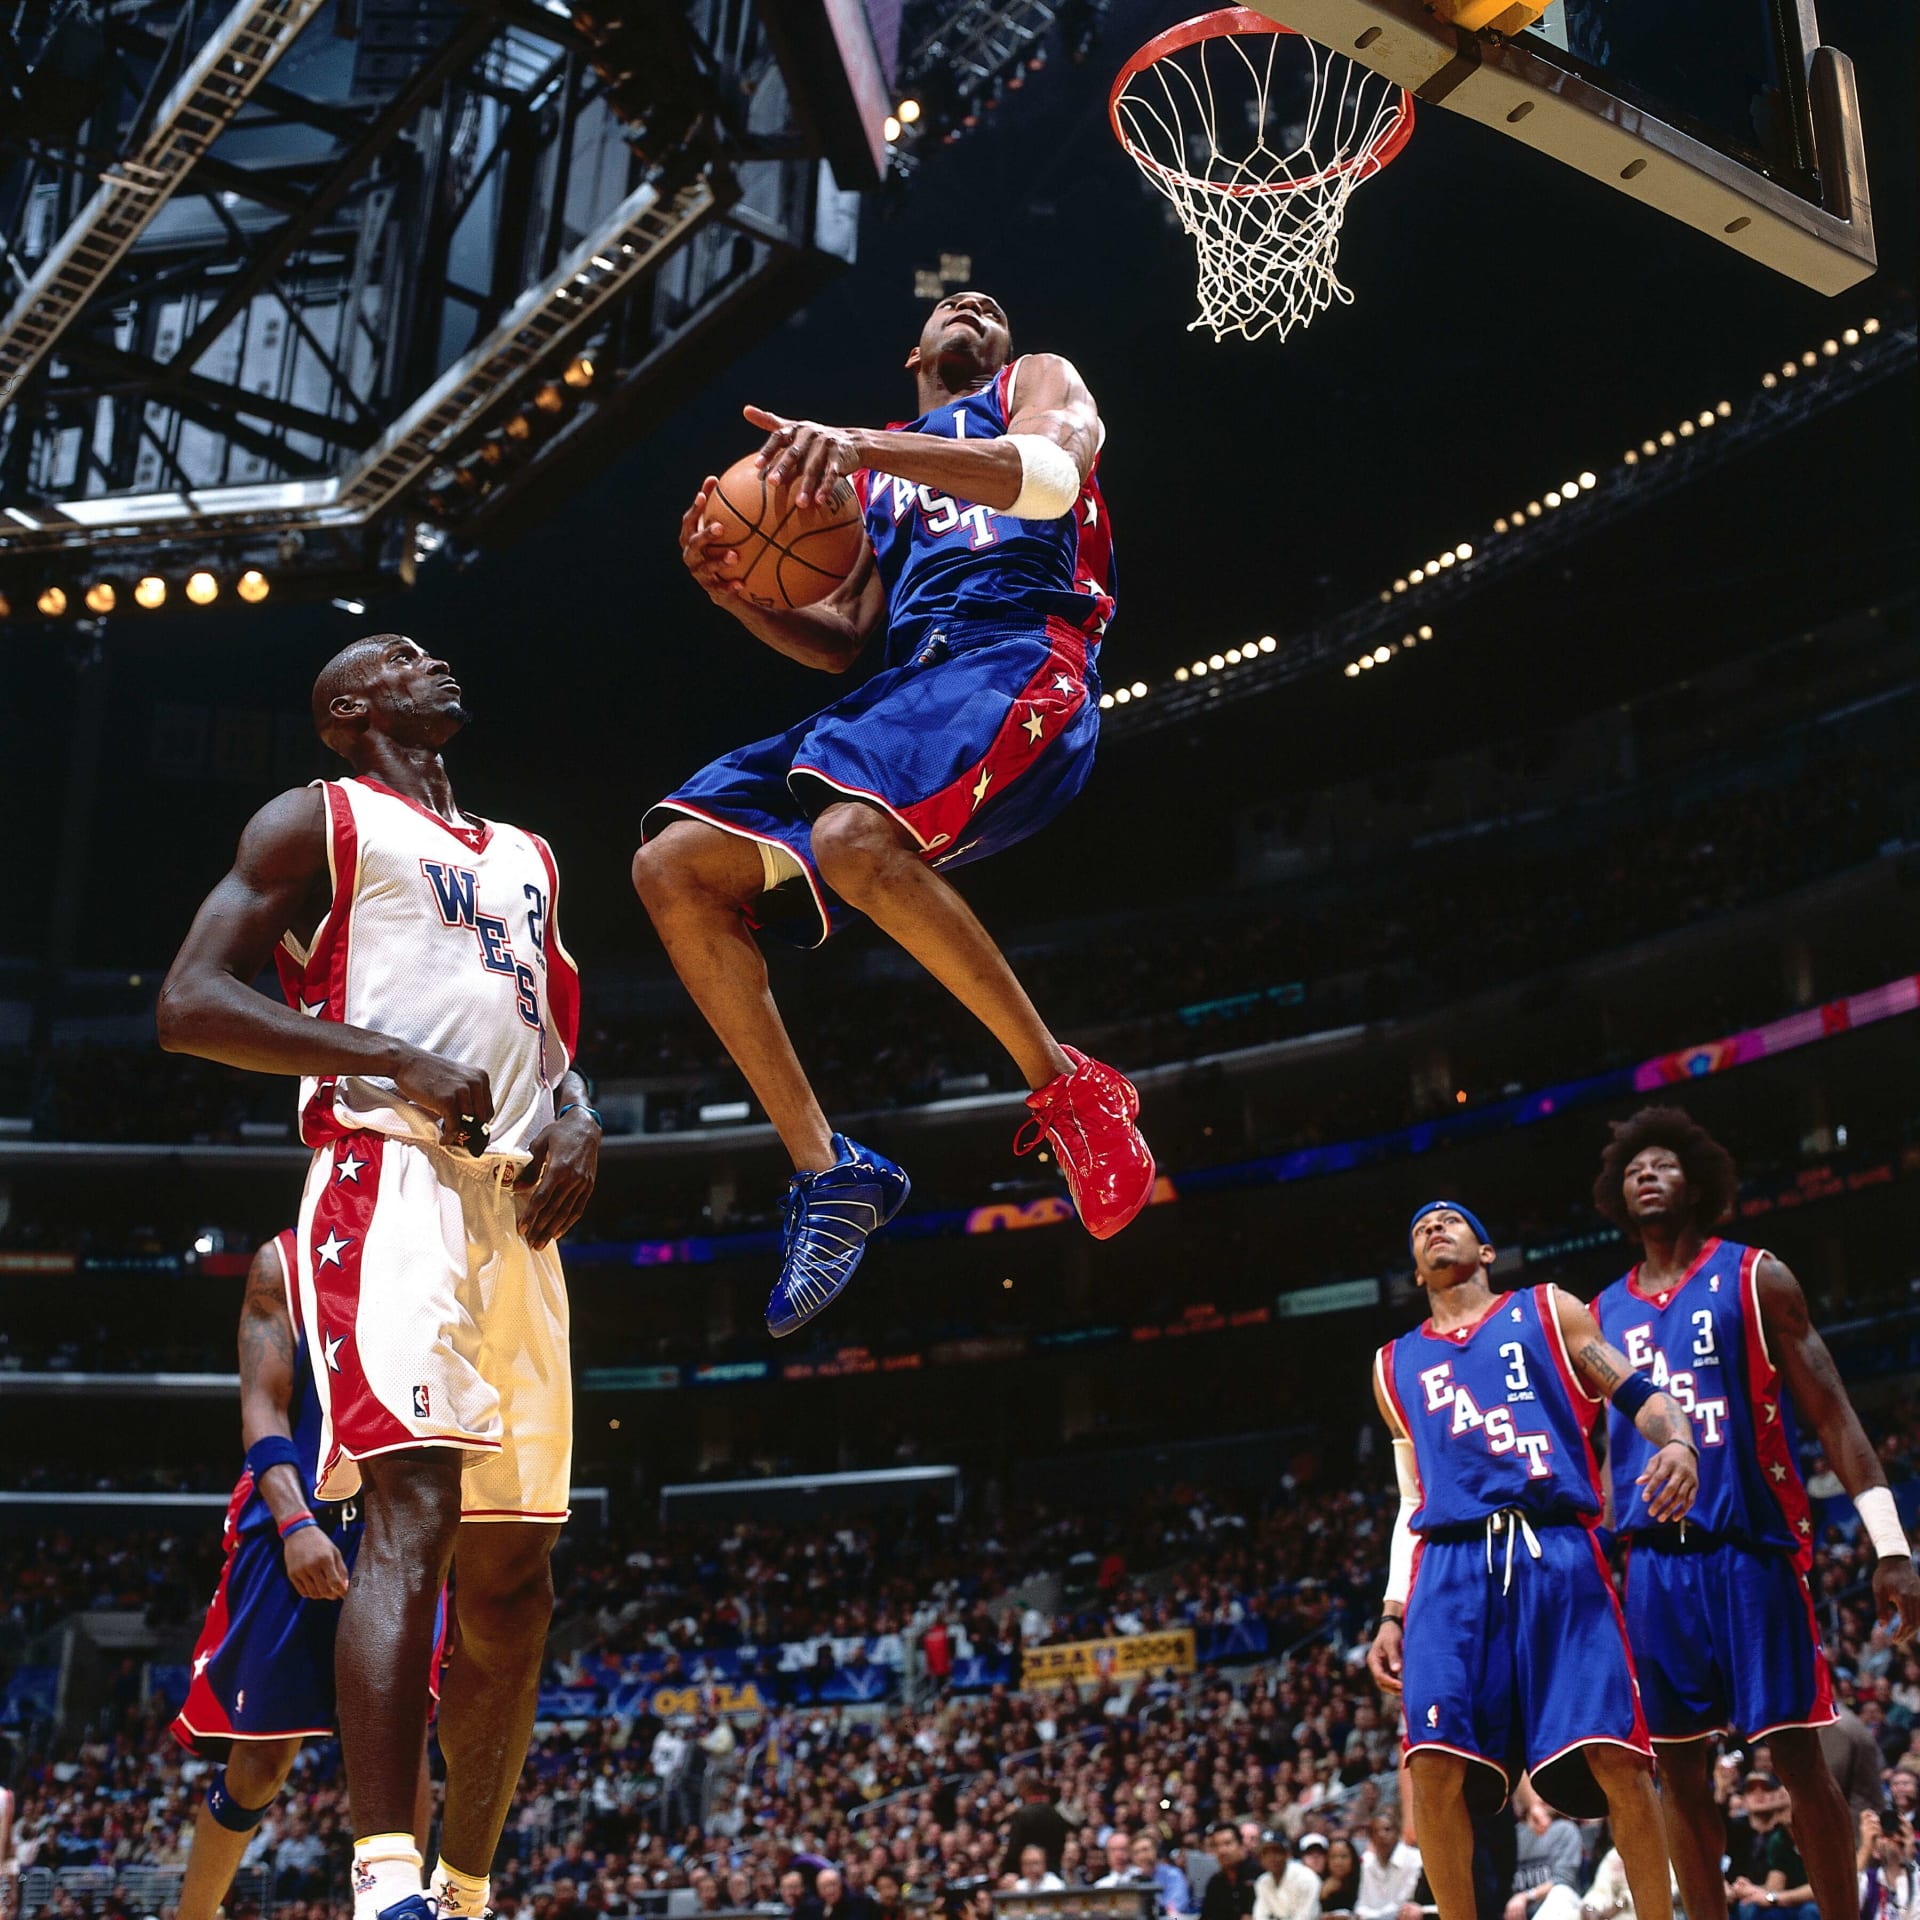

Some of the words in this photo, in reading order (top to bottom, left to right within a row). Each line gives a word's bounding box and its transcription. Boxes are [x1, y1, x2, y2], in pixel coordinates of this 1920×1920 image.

[1499, 1341, 1529, 1390] 3
[1691, 1309, 1715, 1355] 3
[1418, 1359, 1553, 1480] EAST
[1623, 1321, 1729, 1447] EAST
